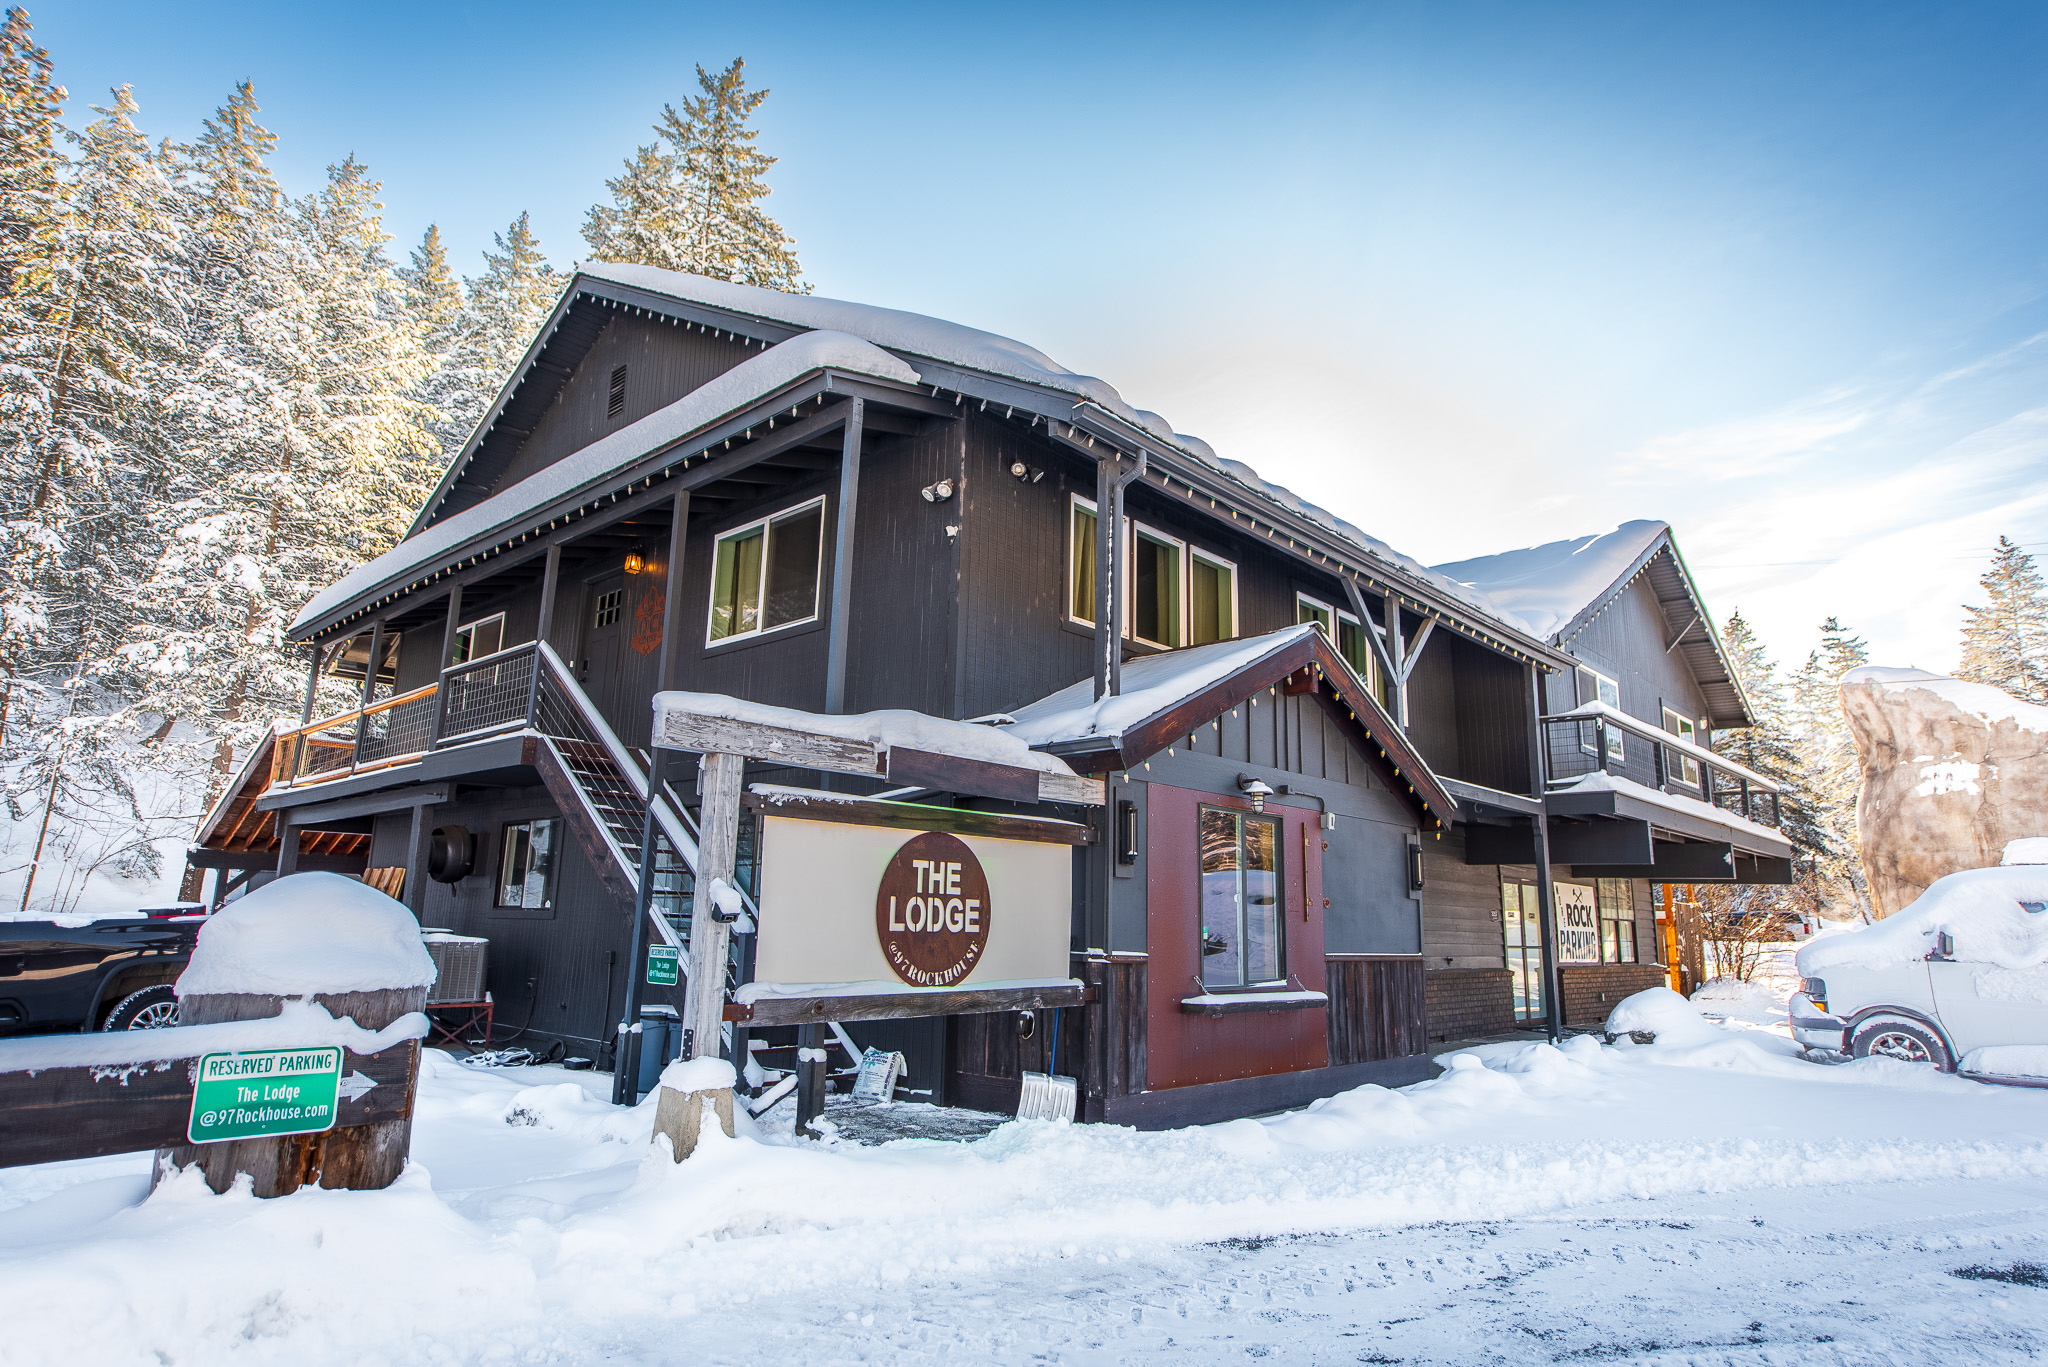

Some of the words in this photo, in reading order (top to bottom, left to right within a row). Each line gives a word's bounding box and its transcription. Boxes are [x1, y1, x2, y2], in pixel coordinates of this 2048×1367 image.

[912, 859, 962, 895] THE
[889, 895, 980, 933] LODGE
[1565, 903, 1594, 928] ROCK
[1559, 930, 1597, 960] PARKING
[888, 940, 980, 986] @97ROCKHOUSE
[209, 1057, 273, 1077] RESERVED
[279, 1053, 332, 1072] PARKING
[237, 1086, 259, 1103] The
[264, 1083, 301, 1104] Lodge
[199, 1104, 328, 1127] @97Rockhouse.com
